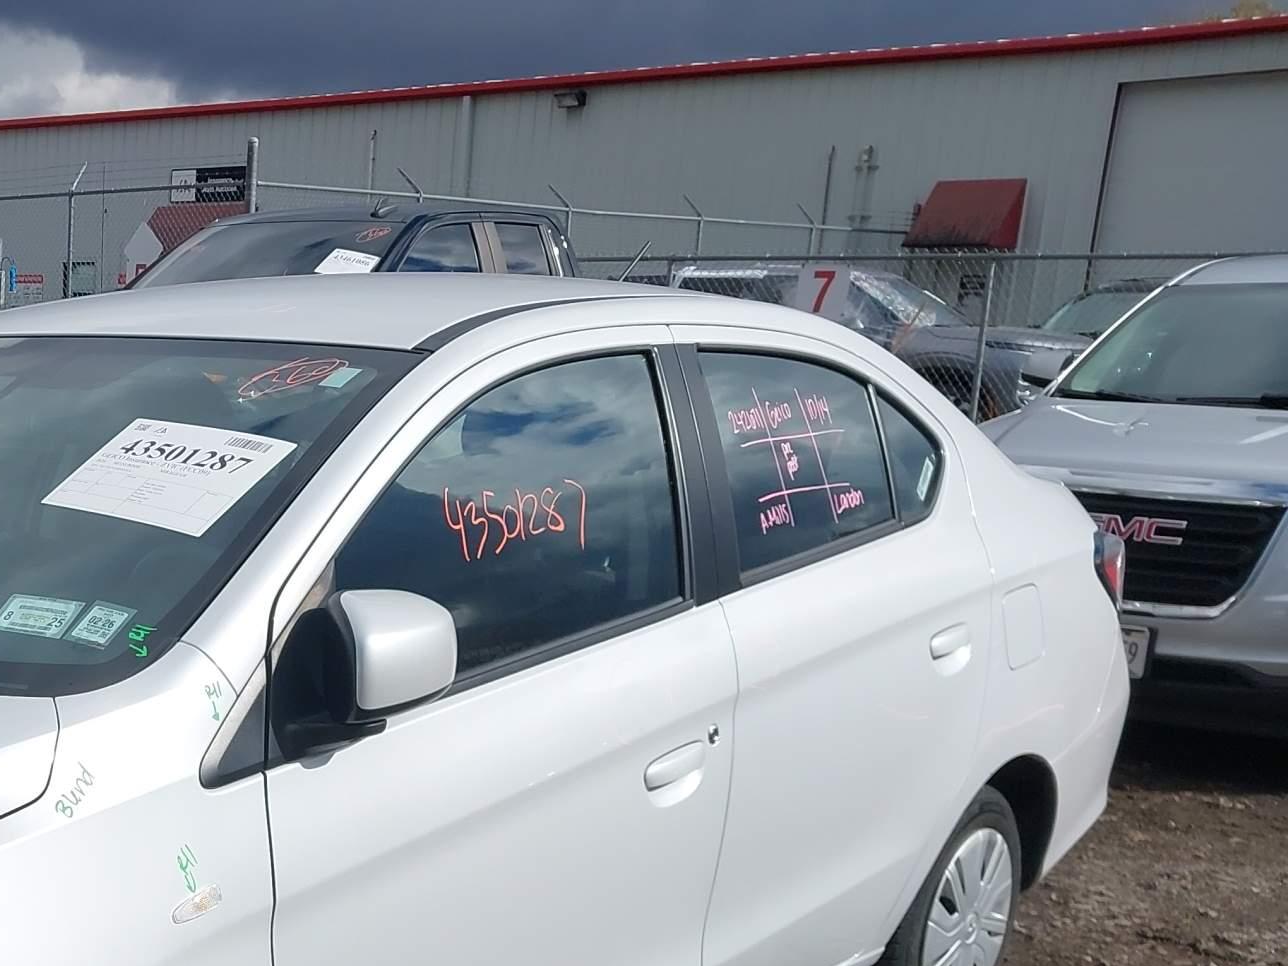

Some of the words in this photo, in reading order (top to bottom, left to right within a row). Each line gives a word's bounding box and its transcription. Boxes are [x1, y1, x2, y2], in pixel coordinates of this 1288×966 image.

[813, 271, 836, 313] 7
[120, 438, 255, 474] 43501287
[443, 479, 587, 563] 43501287
[3, 610, 14, 621] 8
[46, 616, 65, 628] 25
